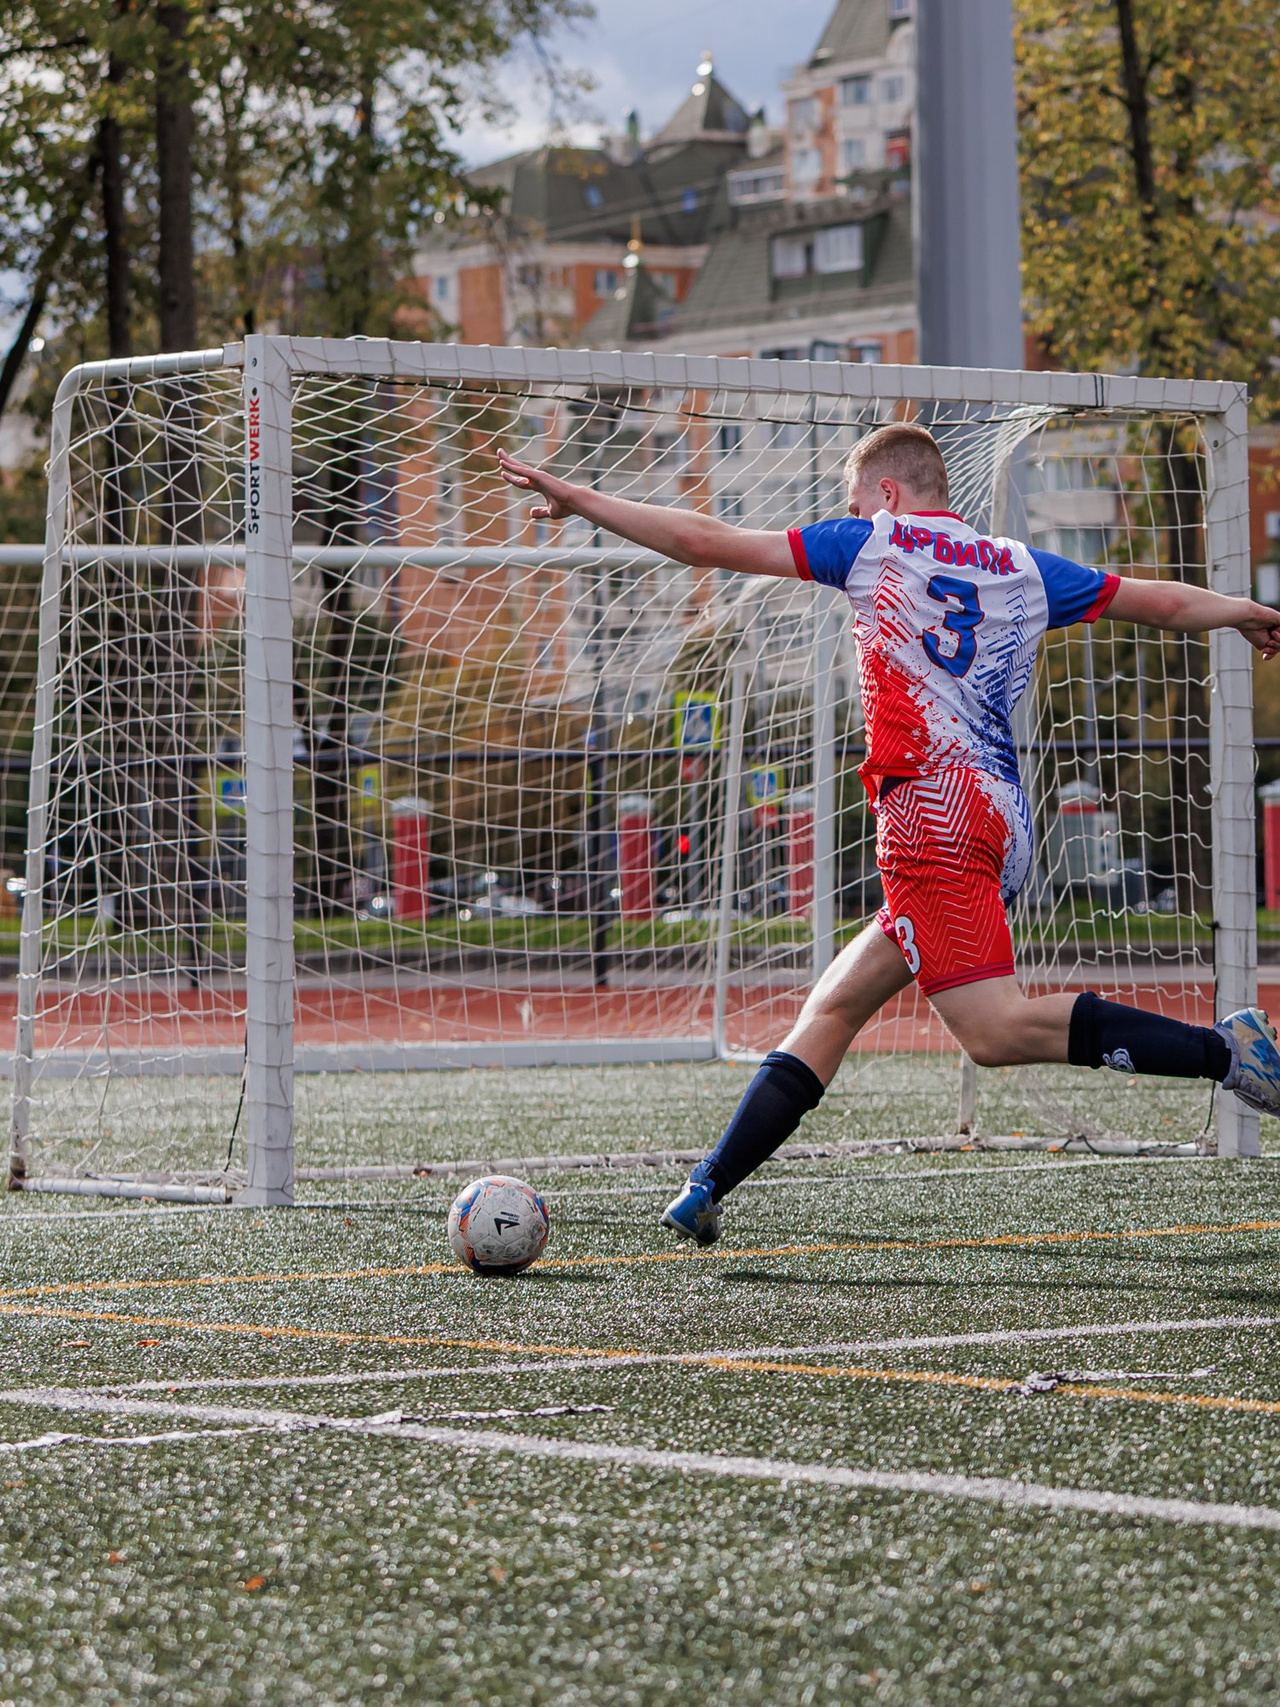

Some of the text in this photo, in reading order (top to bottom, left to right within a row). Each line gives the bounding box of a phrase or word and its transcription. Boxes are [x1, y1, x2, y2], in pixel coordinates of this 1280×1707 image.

[248, 397, 260, 535] SPORTWERK
[922, 574, 985, 679] 3
[894, 914, 922, 975] 3
